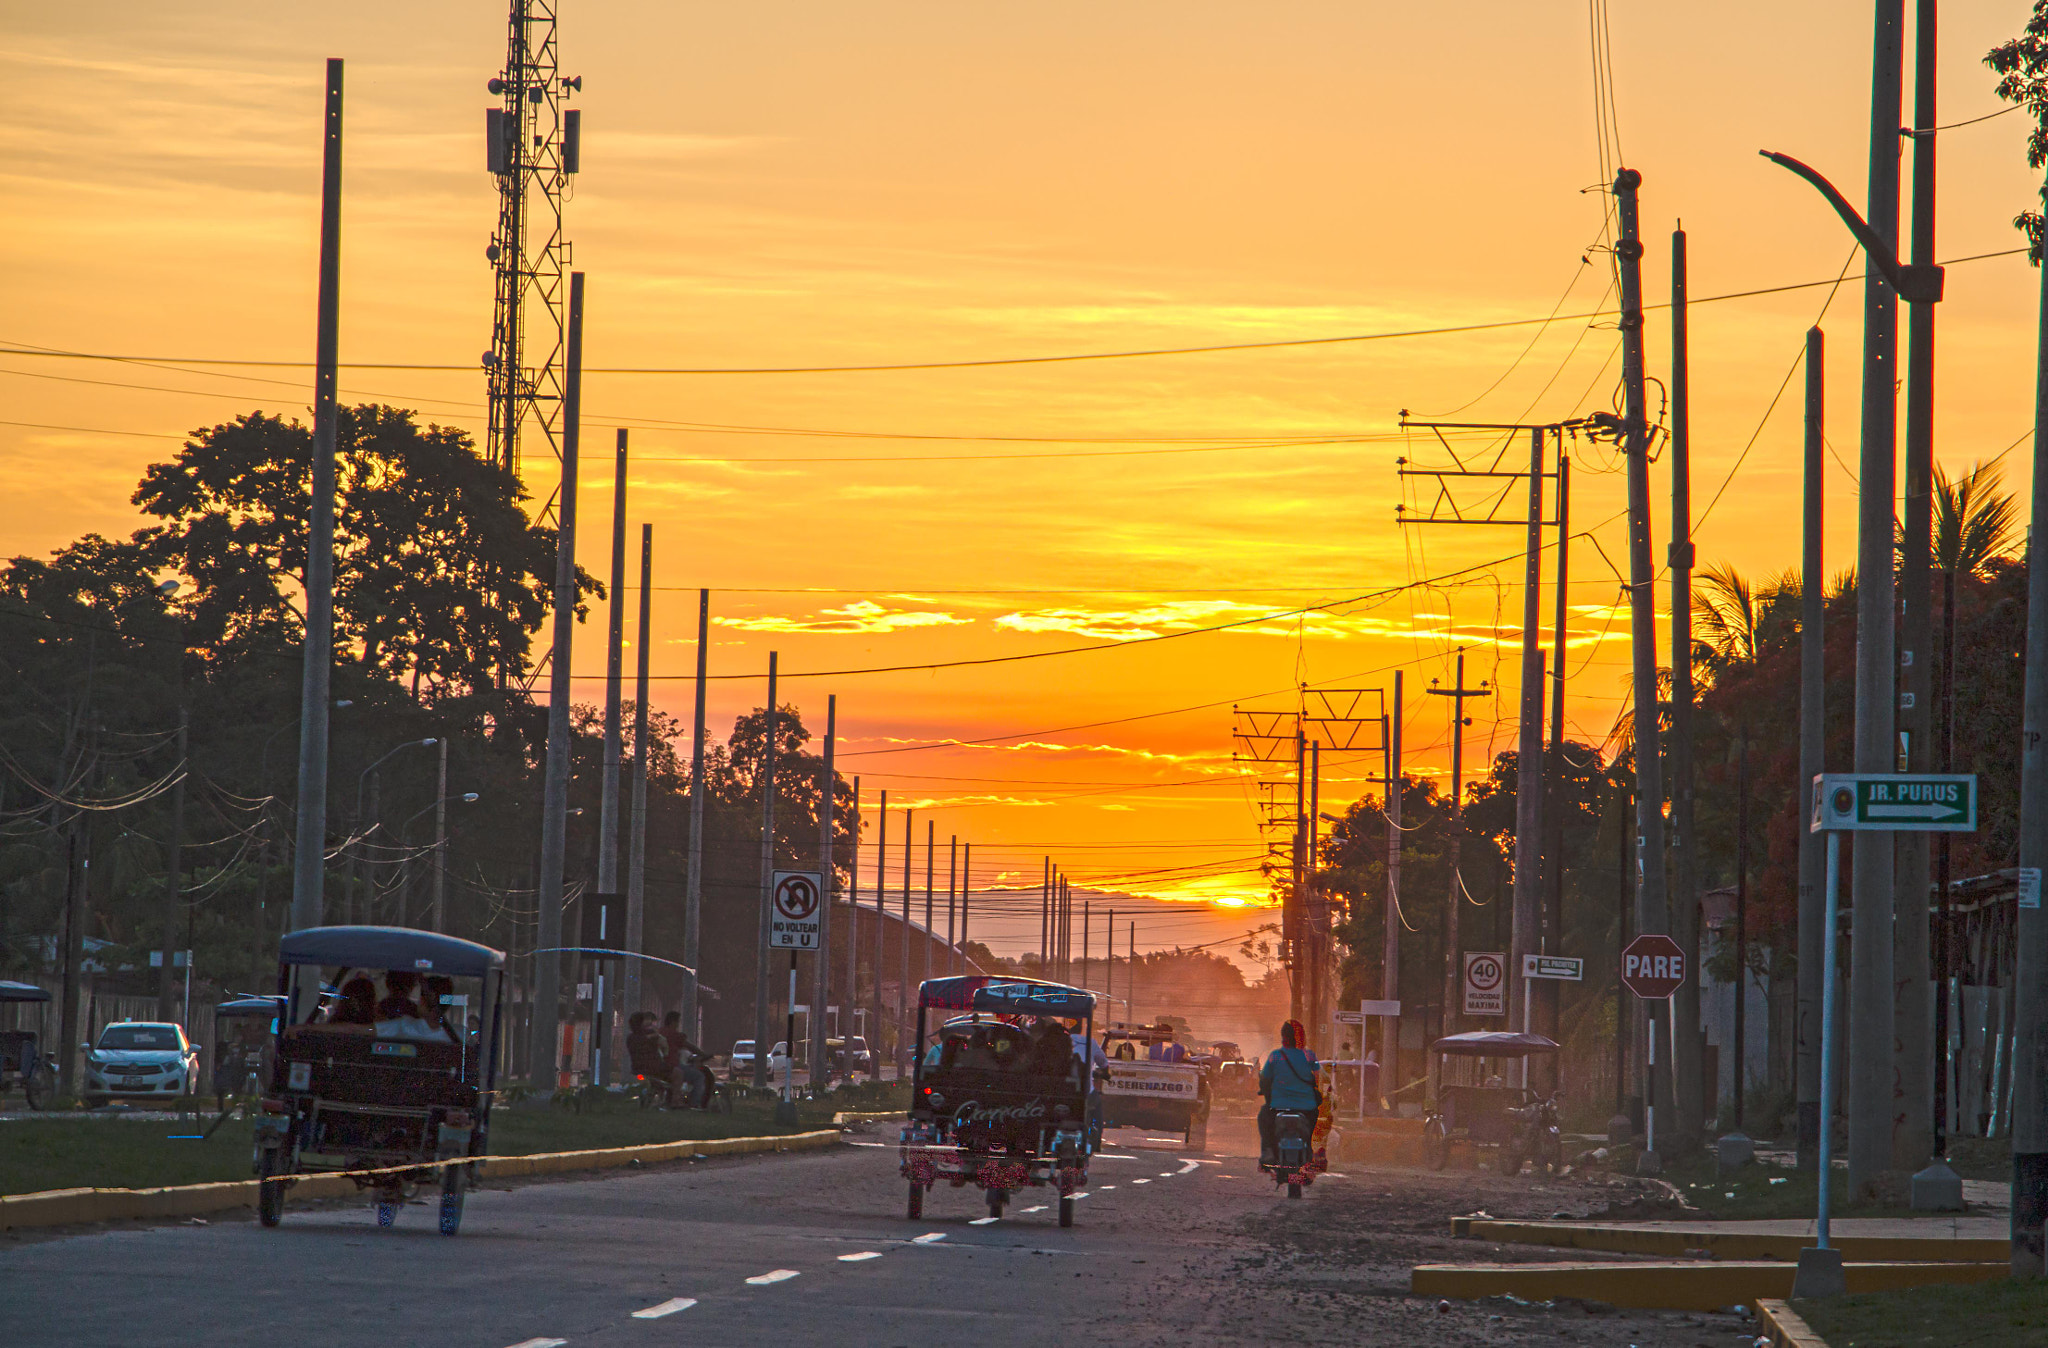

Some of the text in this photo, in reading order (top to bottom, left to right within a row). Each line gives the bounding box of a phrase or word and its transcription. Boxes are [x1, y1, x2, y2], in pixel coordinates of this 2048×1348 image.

[1869, 784, 1958, 801] JR. PURUS
[773, 922, 818, 933] NO VOLTEAR
[781, 934, 811, 946] EN U
[1474, 963, 1496, 978] 40
[1626, 954, 1682, 979] PARE
[1468, 1001, 1500, 1010] MAXIMA
[1117, 1080, 1184, 1093] SERENAZGO
